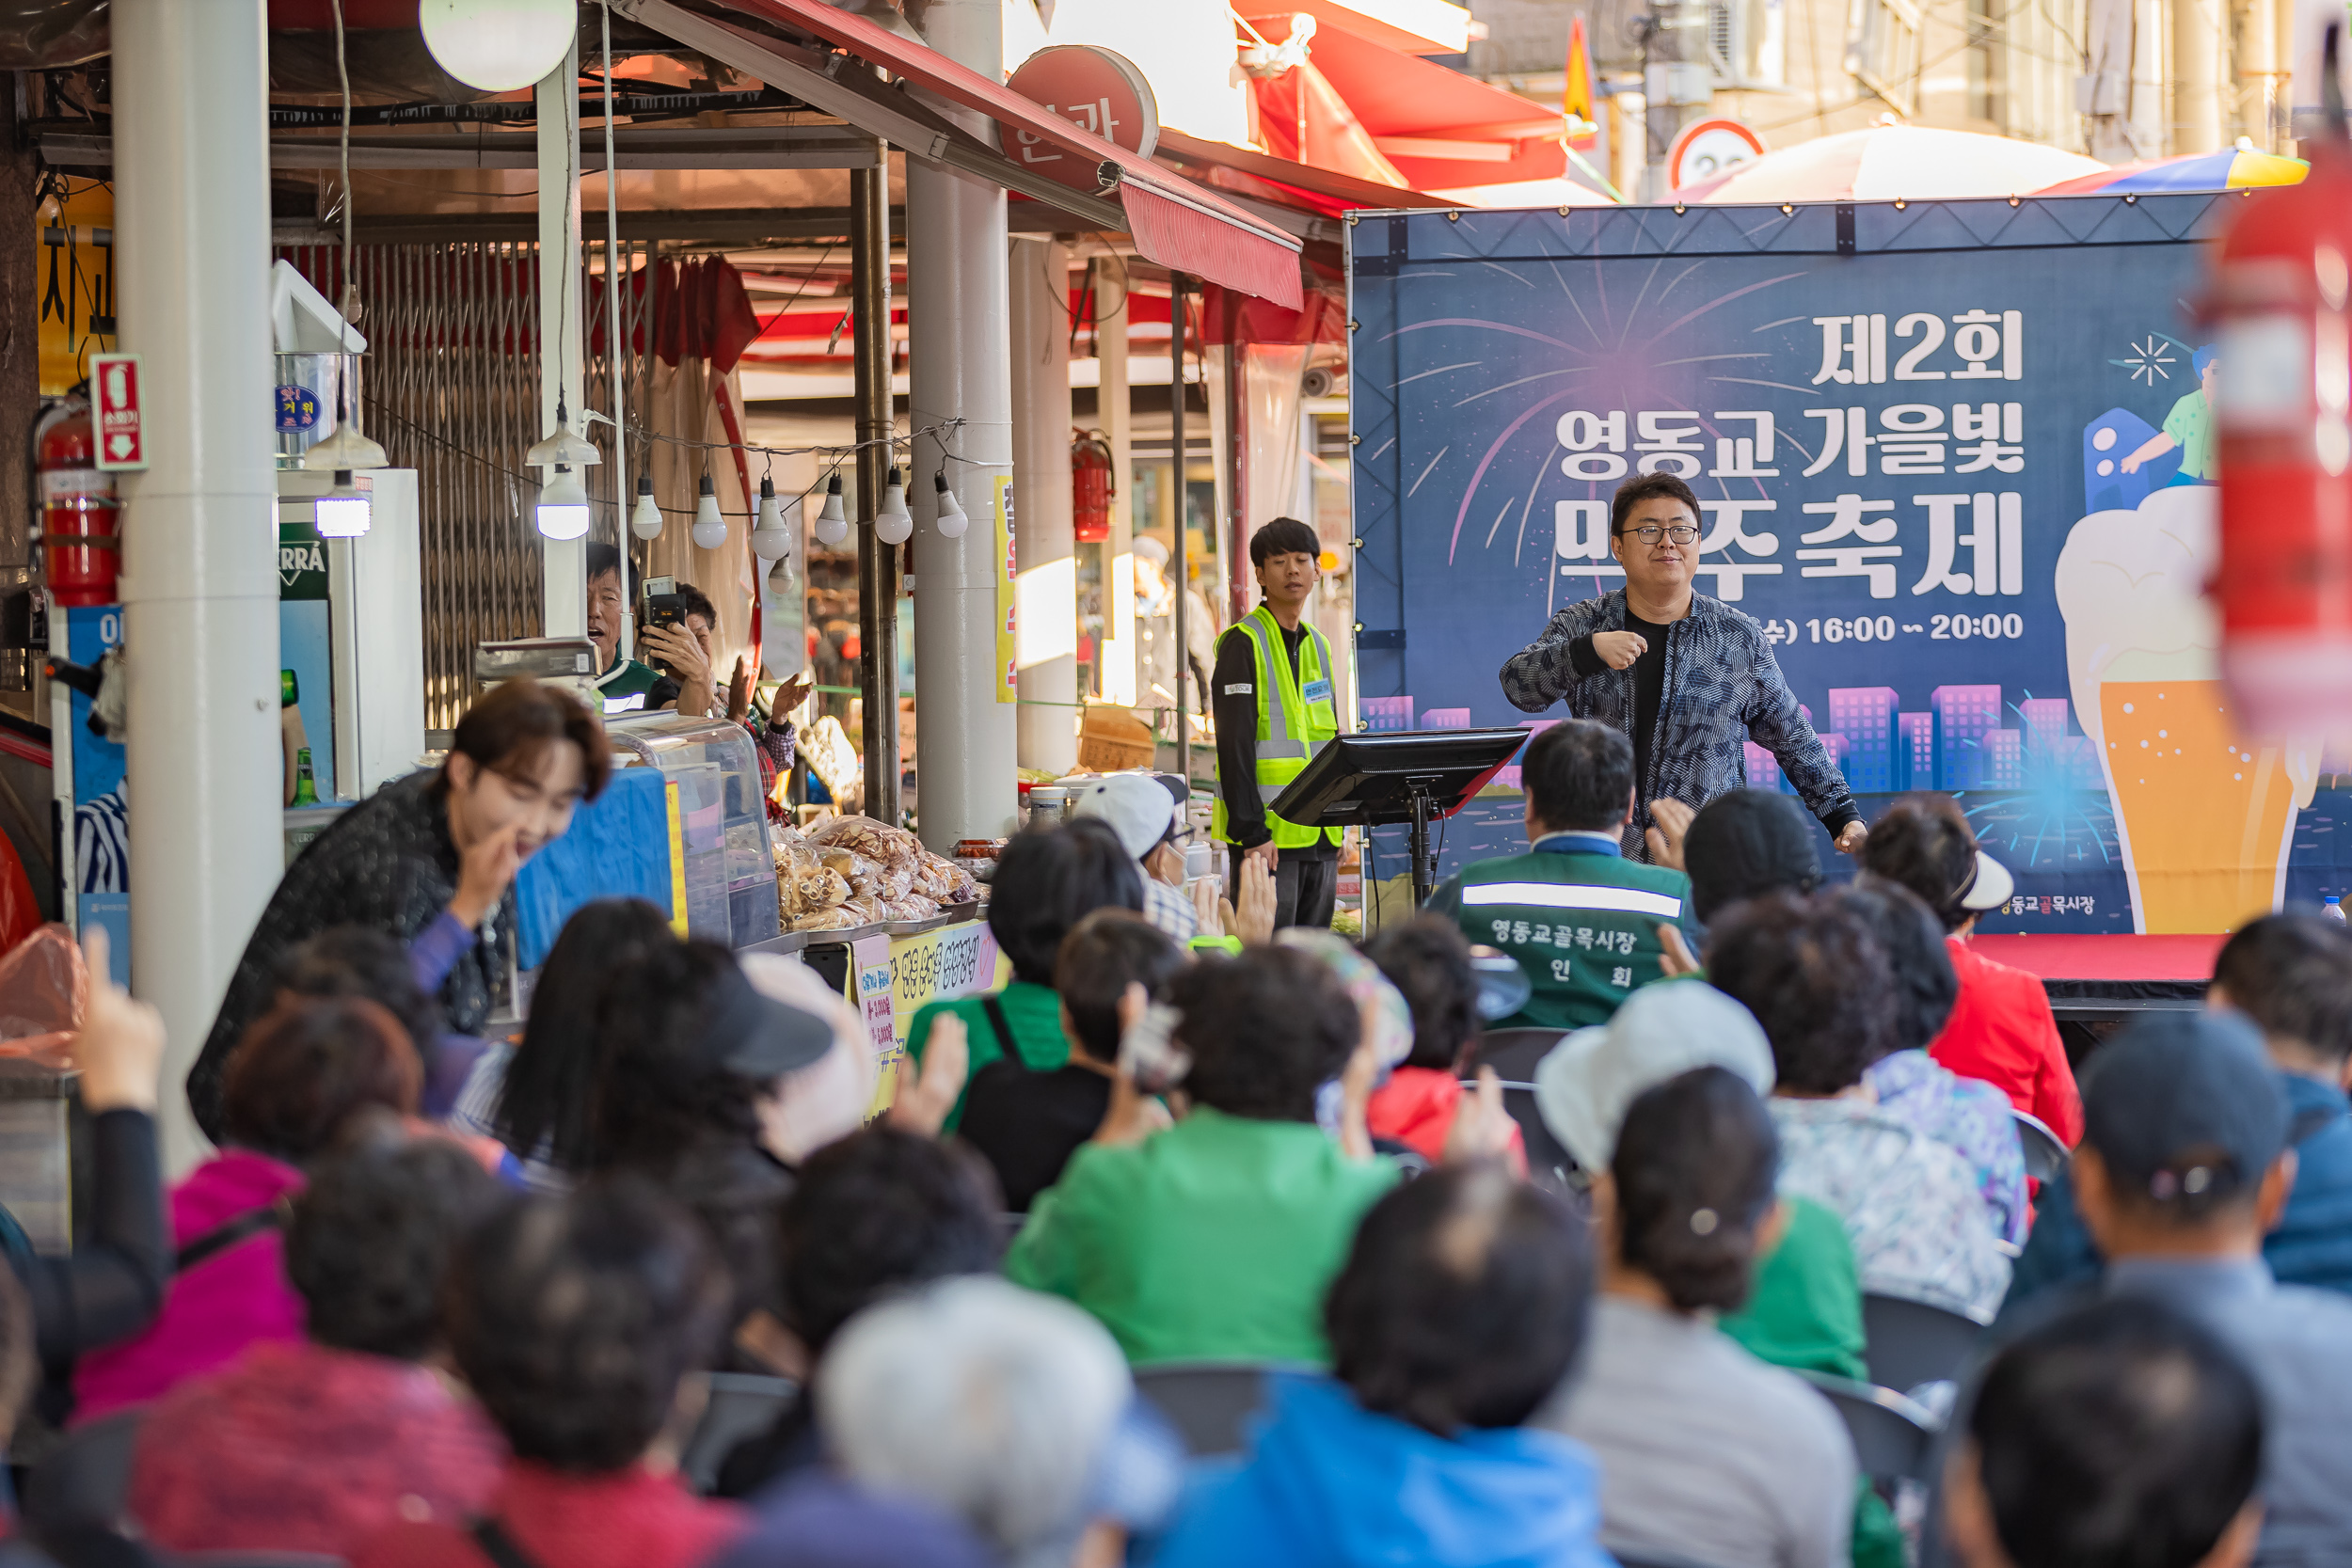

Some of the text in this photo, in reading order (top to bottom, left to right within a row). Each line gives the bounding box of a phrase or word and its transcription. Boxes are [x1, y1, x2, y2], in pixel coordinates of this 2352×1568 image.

[1812, 309, 2023, 386] 제2회
[274, 401, 313, 414] 거워
[1555, 403, 2025, 481] 영동교 가을빛
[1804, 615, 1896, 644] 16:00
[1931, 613, 2024, 640] 20:00
[1490, 919, 1638, 956] 영동교골목시장
[1550, 958, 1632, 988] 인 회
